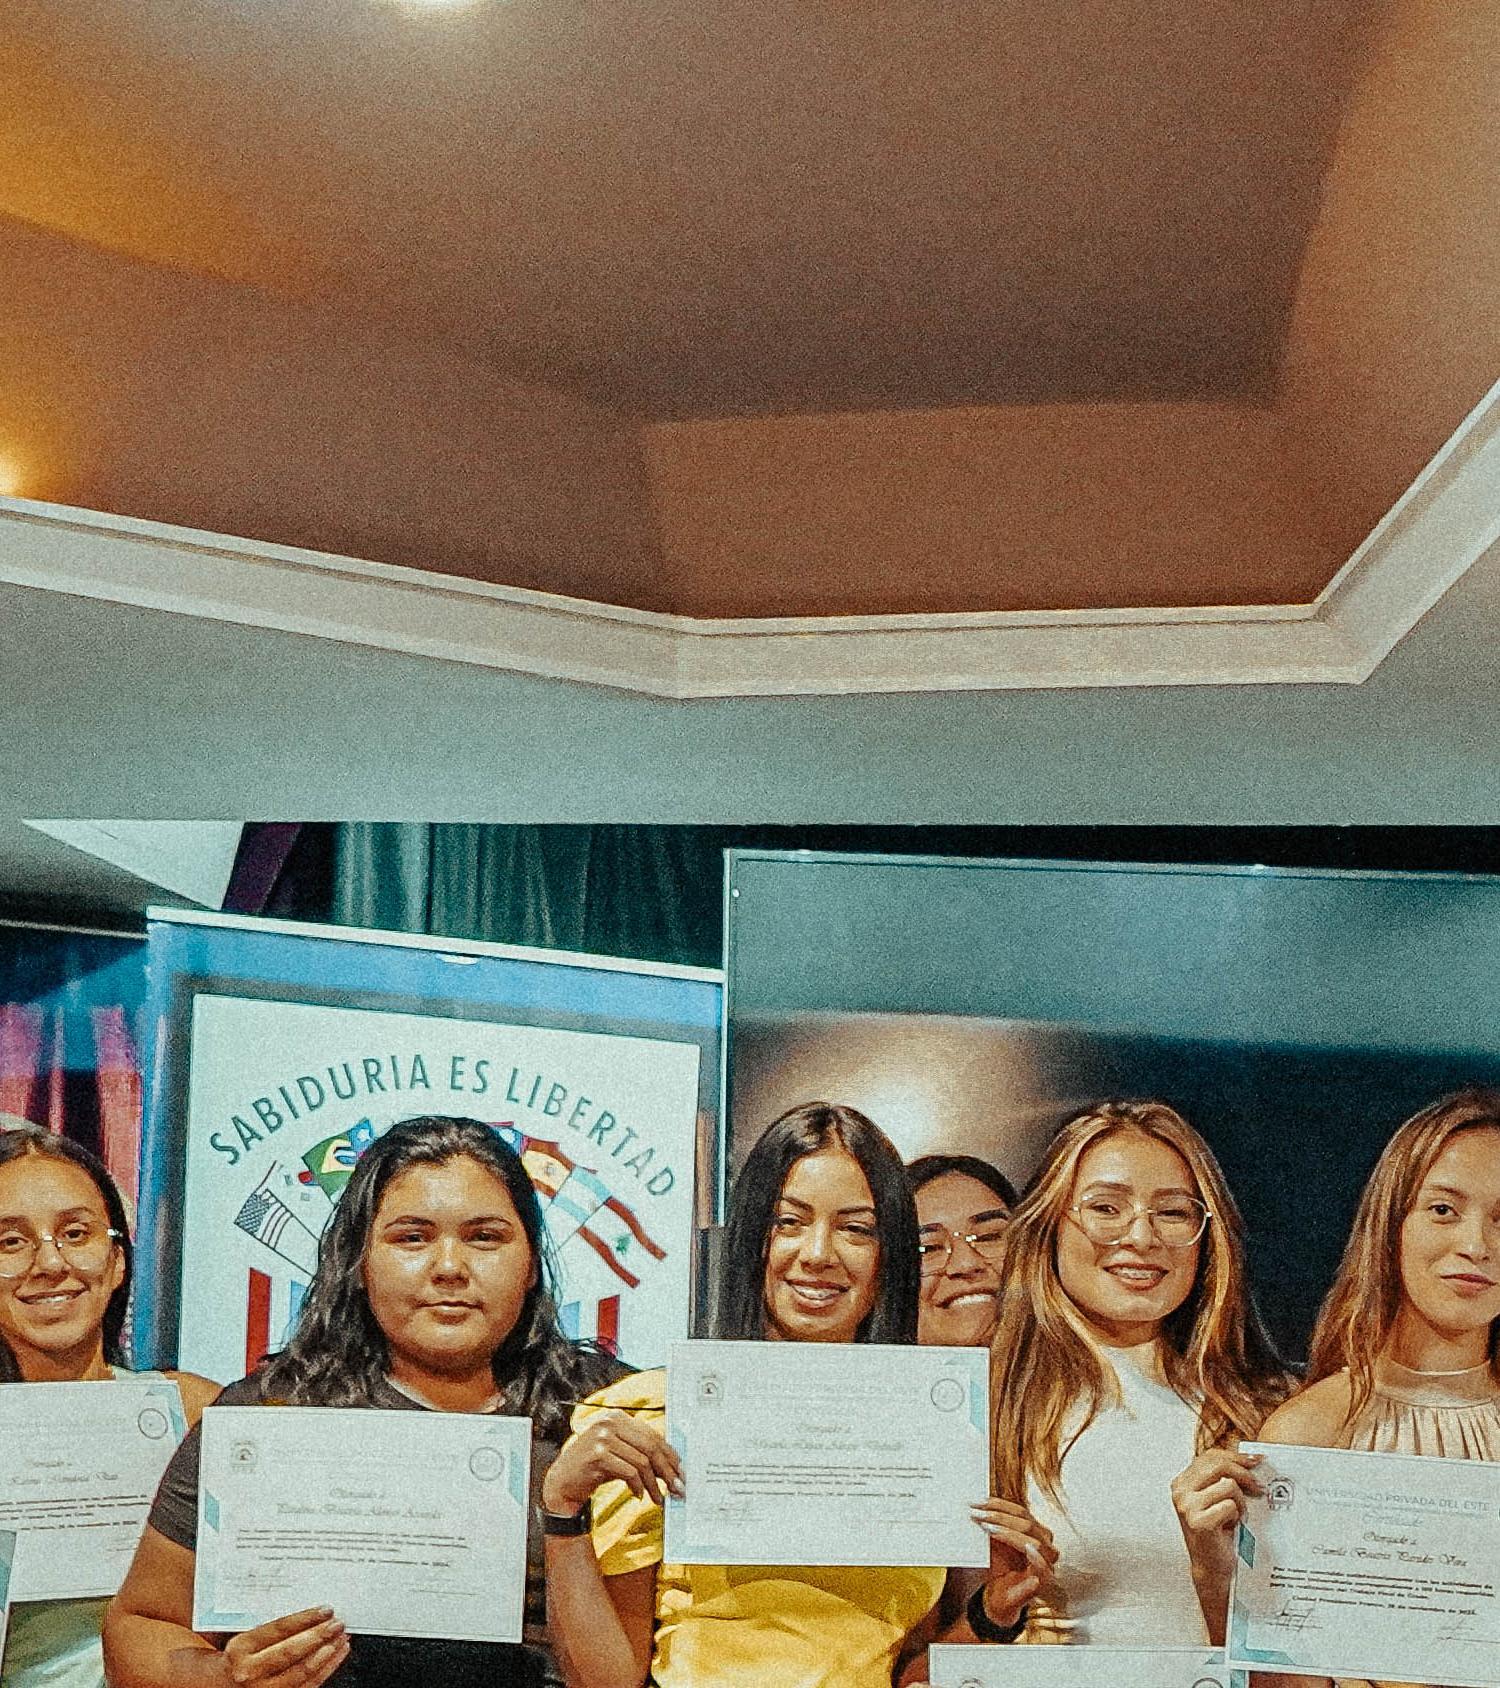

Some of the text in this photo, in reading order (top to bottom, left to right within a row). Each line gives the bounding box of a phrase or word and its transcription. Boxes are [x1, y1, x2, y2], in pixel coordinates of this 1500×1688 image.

[209, 1053, 677, 1199] SABIDURIA ES LIBERTAD
